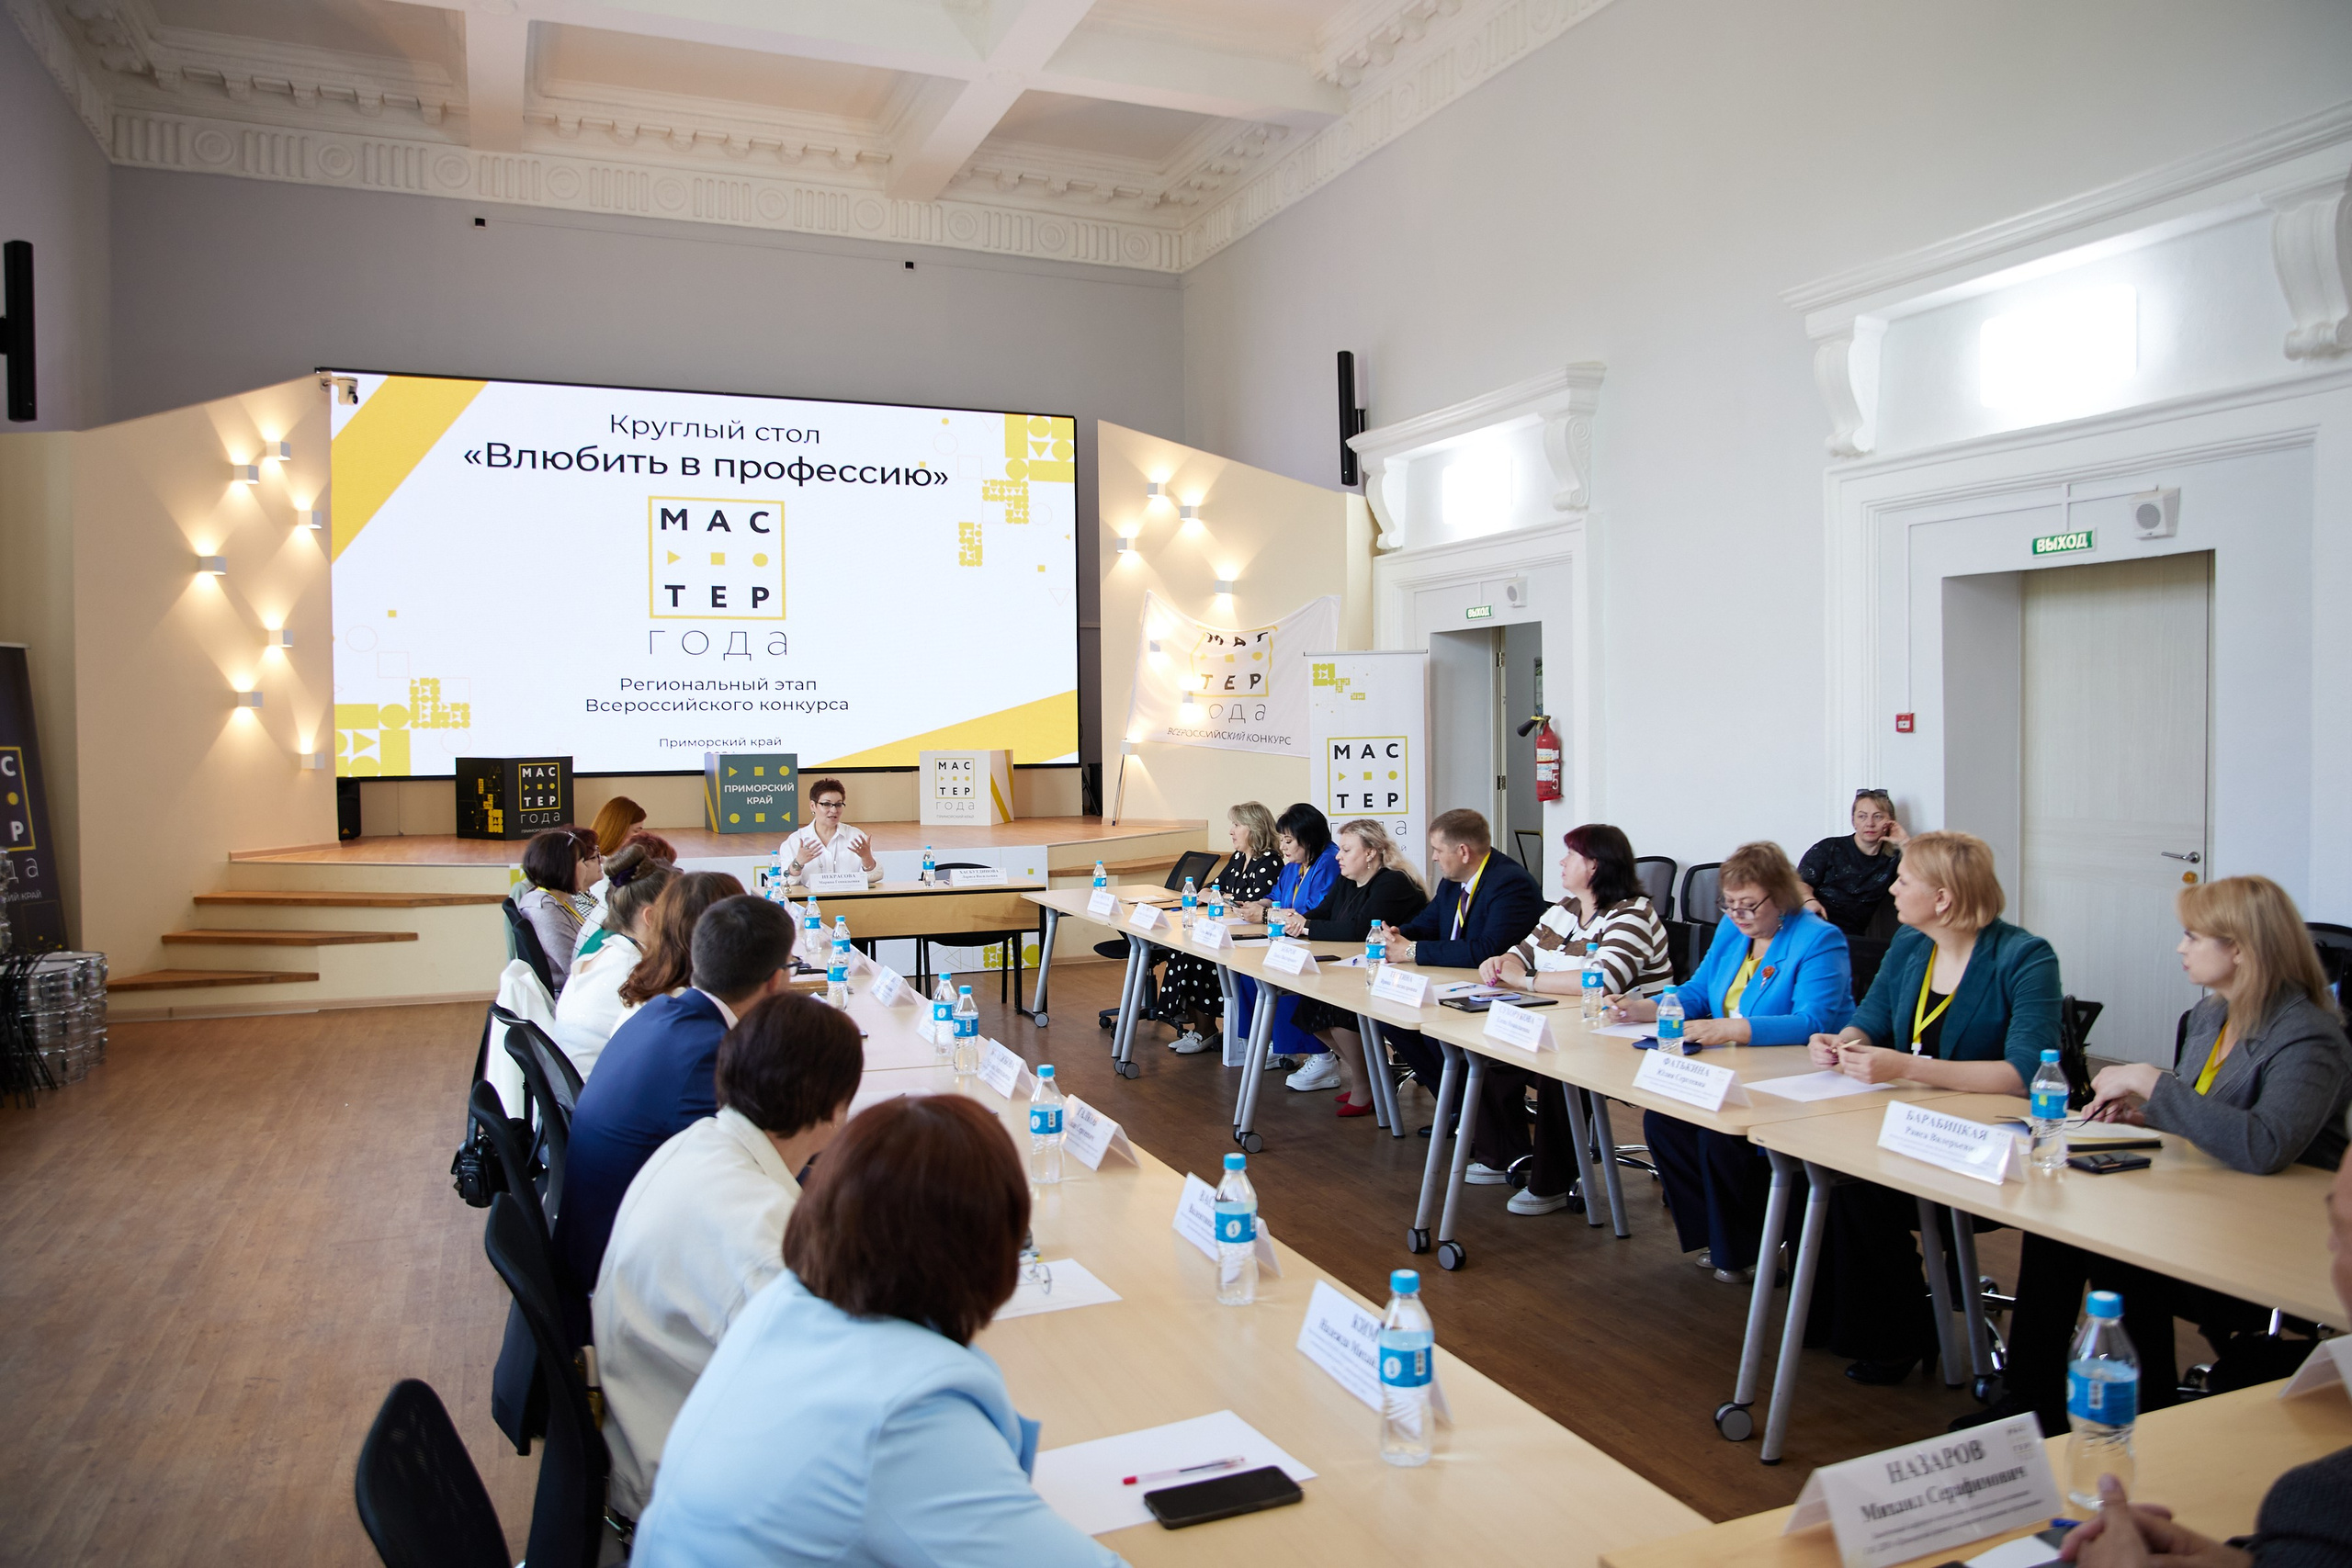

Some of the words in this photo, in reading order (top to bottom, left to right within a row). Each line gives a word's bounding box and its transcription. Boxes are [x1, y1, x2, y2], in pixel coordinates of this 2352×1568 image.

[610, 413, 744, 441] Круглый
[754, 426, 820, 445] стол
[464, 442, 669, 475] «Влюбить
[681, 457, 701, 477] в
[714, 456, 949, 488] профессию»
[660, 507, 771, 535] МАС
[2036, 532, 2088, 553] ВЫХОД
[663, 584, 770, 609] ТЕР
[1468, 606, 1490, 618] ВЫХОД
[649, 629, 788, 661] года
[620, 678, 768, 692] Региональный
[775, 680, 817, 692] этап
[586, 698, 753, 716] Всероссийского
[760, 701, 849, 715] конкурса
[1208, 704, 1267, 724] ода
[659, 738, 747, 749] Приморский
[751, 738, 782, 748] край
[1167, 727, 1246, 741] ВСЕРОССИЙСКИЙ
[1247, 734, 1292, 745] КОНКУРС
[1334, 743, 1399, 760] МАС
[522, 767, 556, 777] МАС
[938, 761, 970, 770] МАС
[724, 783, 795, 793] ПРИМОРСКИЙ
[940, 787, 970, 795] ТЕР
[523, 795, 556, 807] ТЕР
[746, 795, 773, 805] КРАЙ
[936, 802, 975, 811] года
[1336, 793, 1399, 808] ТЕР
[520, 812, 560, 824] года
[1905, 1110, 1989, 1141] БАРАБИЦКАЯ
[1884, 1438, 1986, 1484] НАЗАРОВ
[1860, 1495, 1924, 1523] Михаил
[1925, 1465, 2029, 1505] Серафимович
